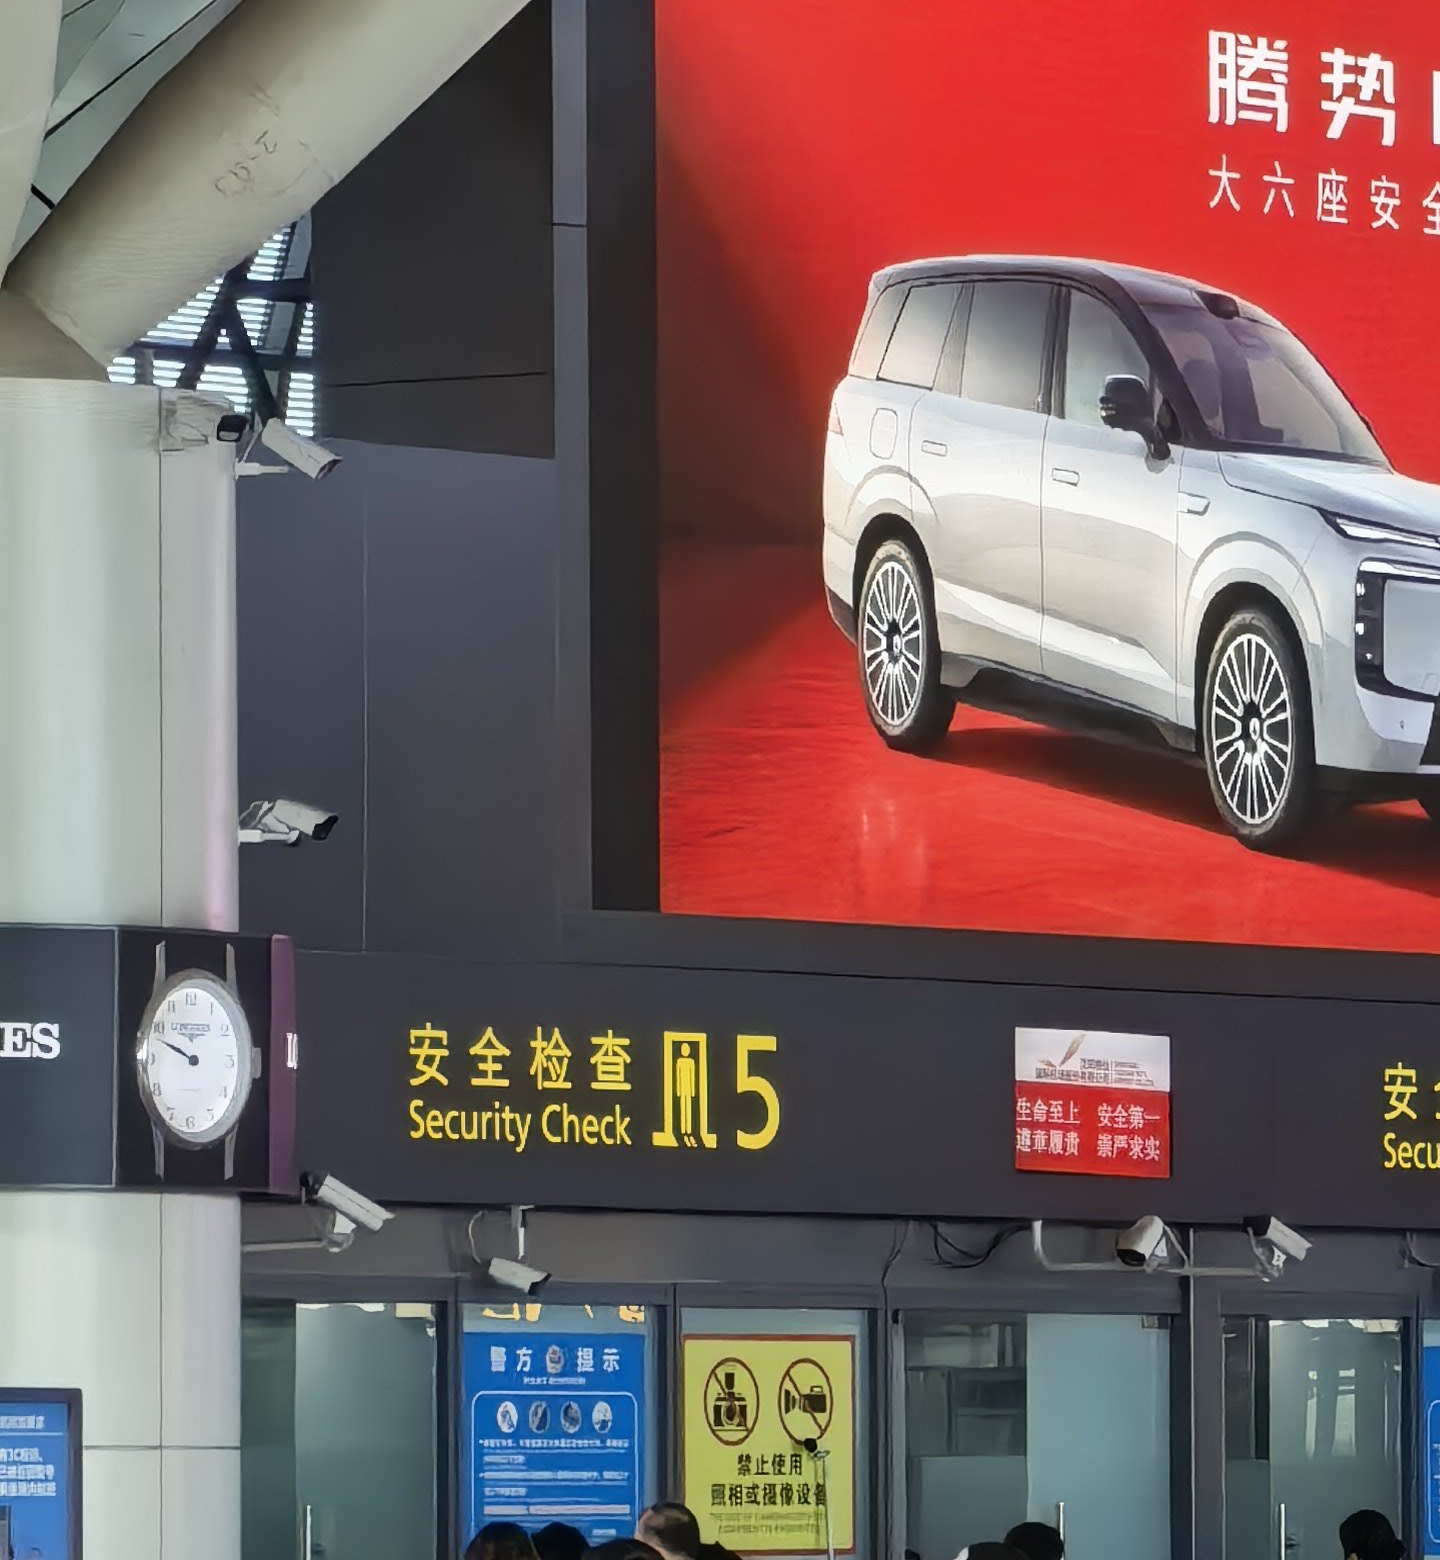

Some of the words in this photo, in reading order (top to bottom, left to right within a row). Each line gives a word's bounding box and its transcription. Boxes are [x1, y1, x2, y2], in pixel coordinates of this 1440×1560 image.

[1209, 30, 1395, 146] 腾势
[0, 1022, 60, 1059] ES
[409, 1023, 631, 1090] 安全检查
[410, 1099, 531, 1152] Security
[542, 1103, 631, 1145] Check
[737, 1035, 779, 1149] 5
